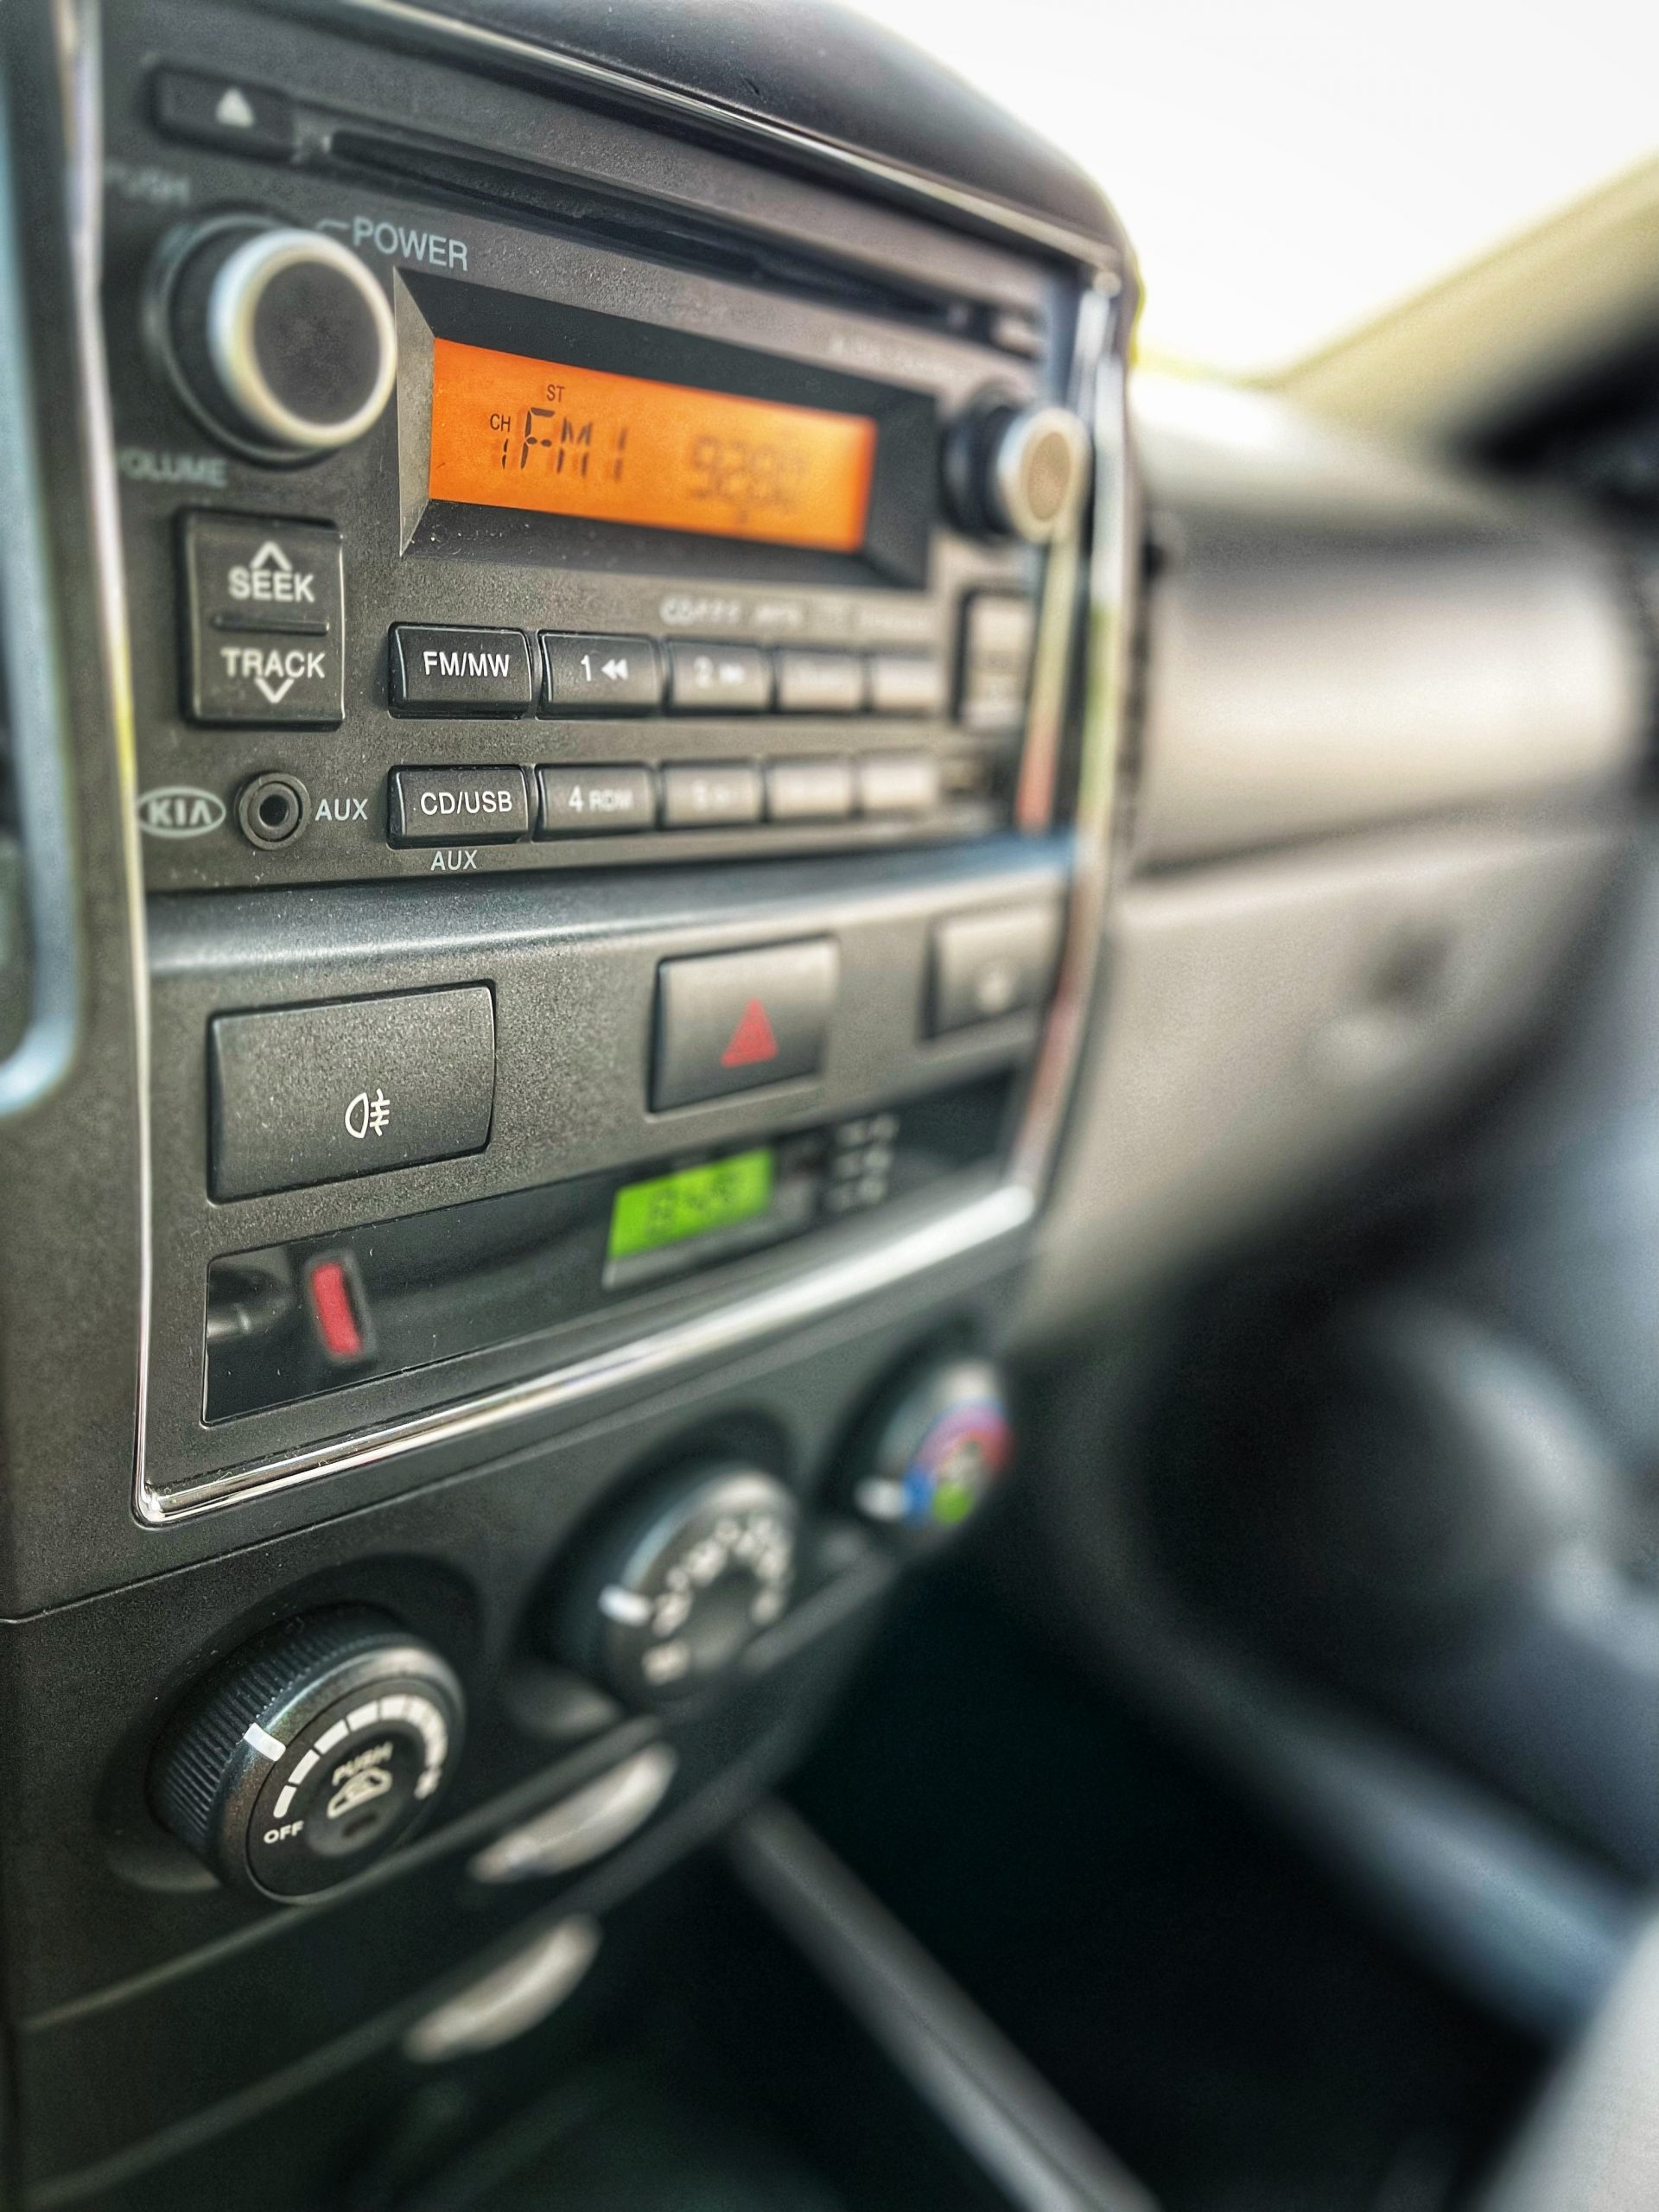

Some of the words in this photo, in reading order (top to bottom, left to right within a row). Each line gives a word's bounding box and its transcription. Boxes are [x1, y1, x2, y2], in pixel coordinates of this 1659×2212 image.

[353, 215, 468, 272] POWER
[546, 384, 565, 403] ST
[490, 413, 512, 433] CH
[117, 447, 228, 489] OLUME
[228, 567, 315, 603] SEEK
[220, 647, 326, 679] TRACK
[423, 651, 511, 678] FM/MW
[580, 653, 593, 683] 1
[146, 798, 214, 826] KIA
[315, 798, 369, 822] AUX
[420, 791, 513, 817] CD/USB
[568, 785, 584, 813] 4
[430, 849, 478, 871] AUX
[263, 1820, 305, 1845] OFF
